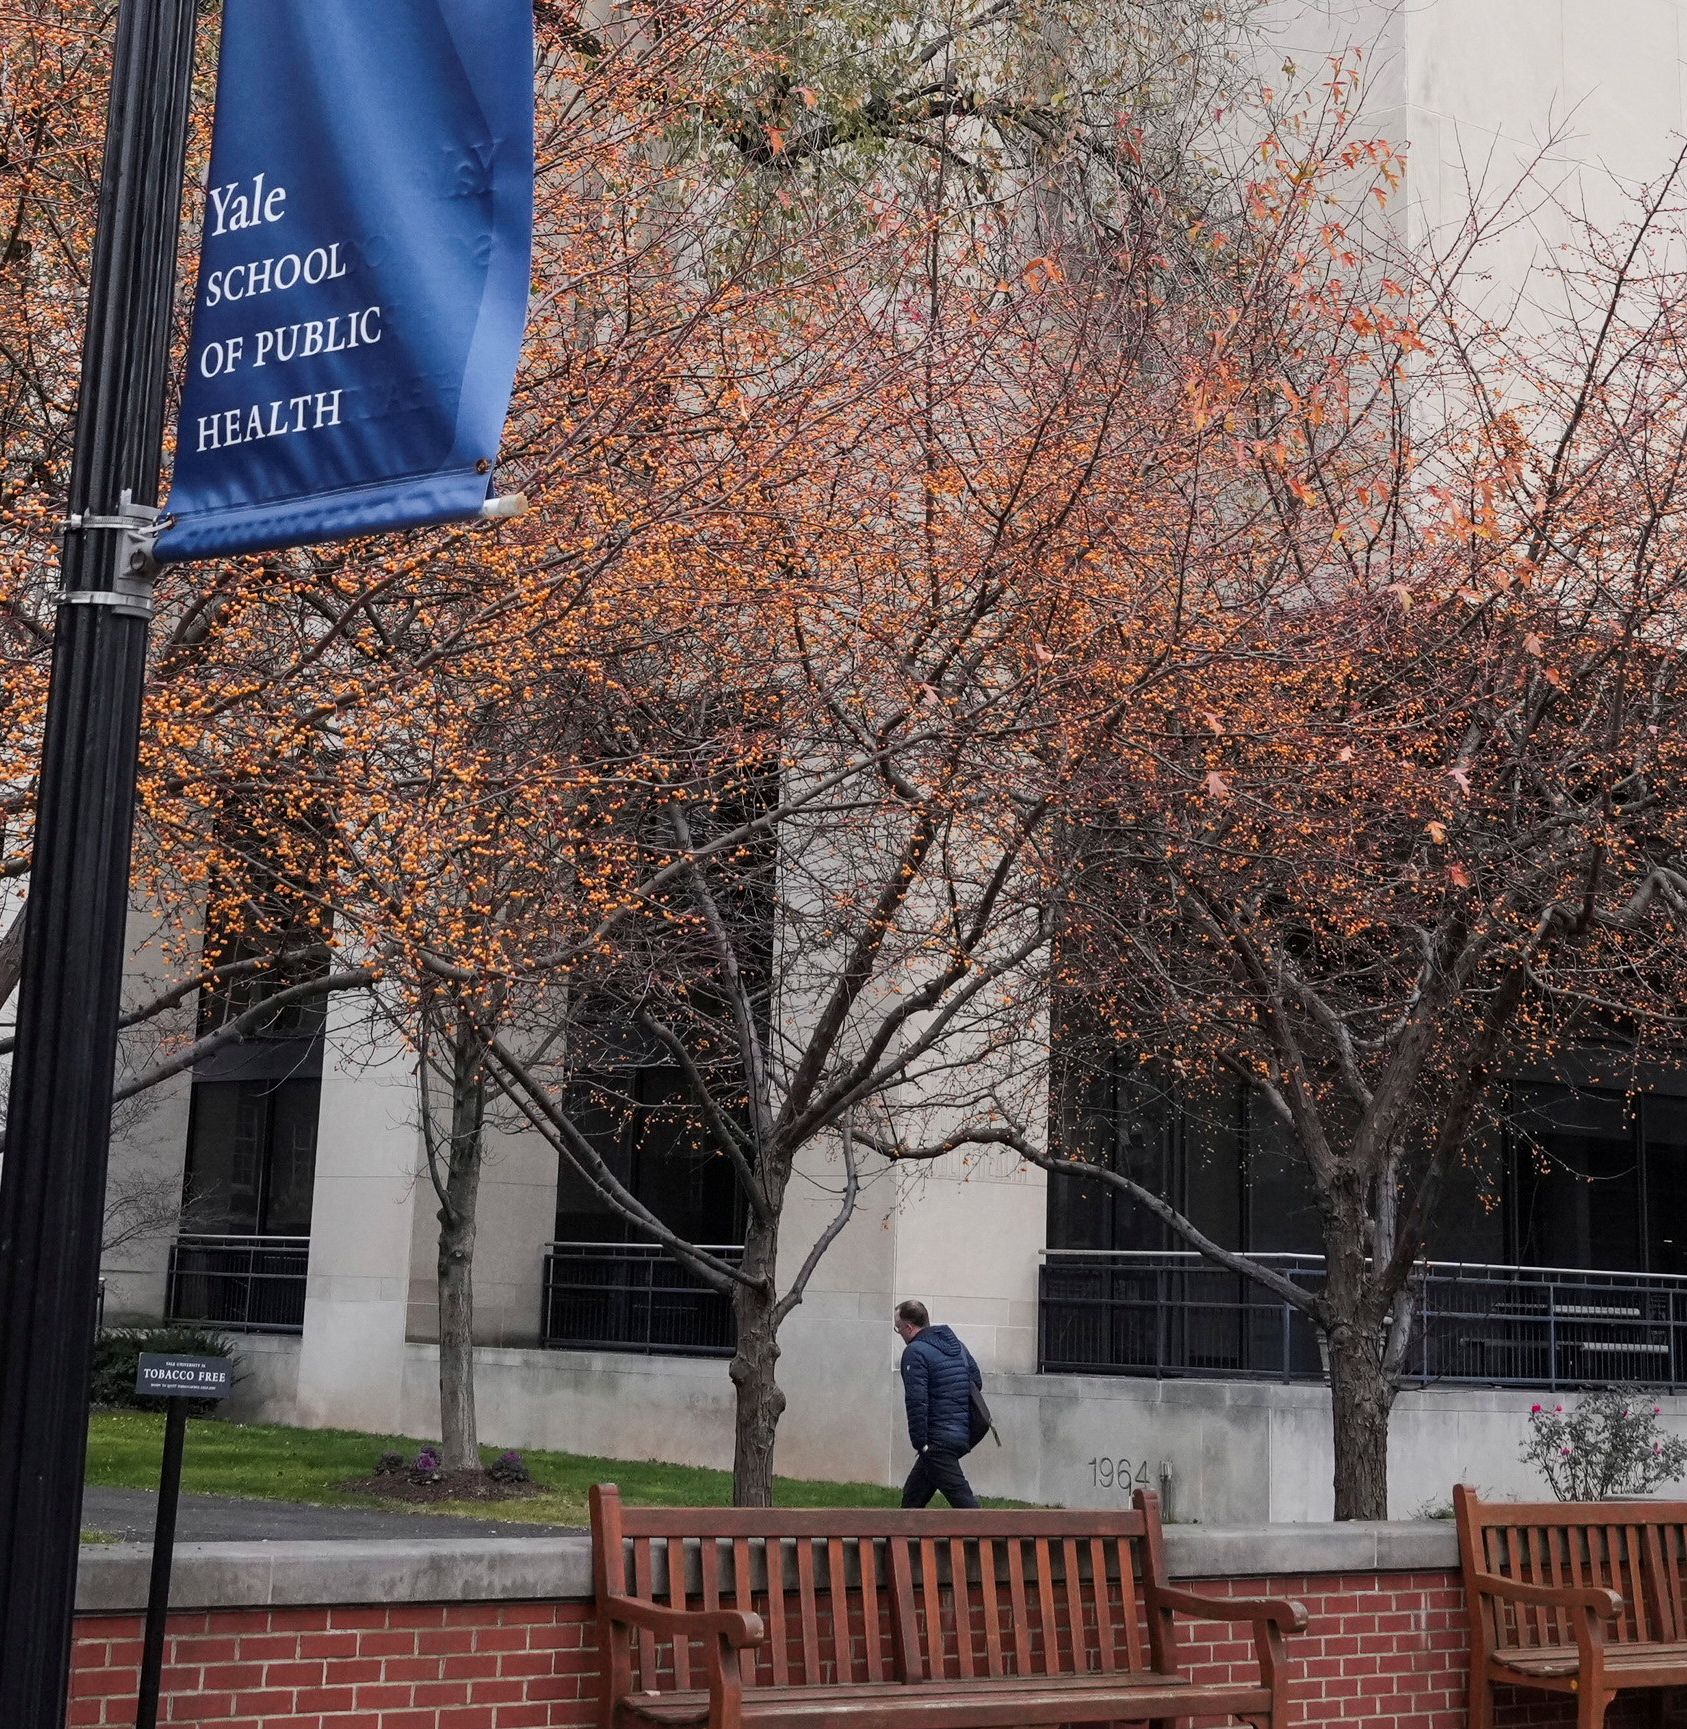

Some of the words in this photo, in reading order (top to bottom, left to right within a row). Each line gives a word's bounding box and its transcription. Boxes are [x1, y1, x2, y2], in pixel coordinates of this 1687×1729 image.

[210, 173, 286, 237] Yale
[206, 243, 346, 307] SCHOOL
[201, 337, 243, 379] OF
[253, 306, 382, 368] PUBLIC
[196, 389, 343, 453] HEALTH
[144, 1368, 195, 1381] TOBACCO
[198, 1371, 226, 1383] FREE
[1088, 1457, 1150, 1489] 1964
